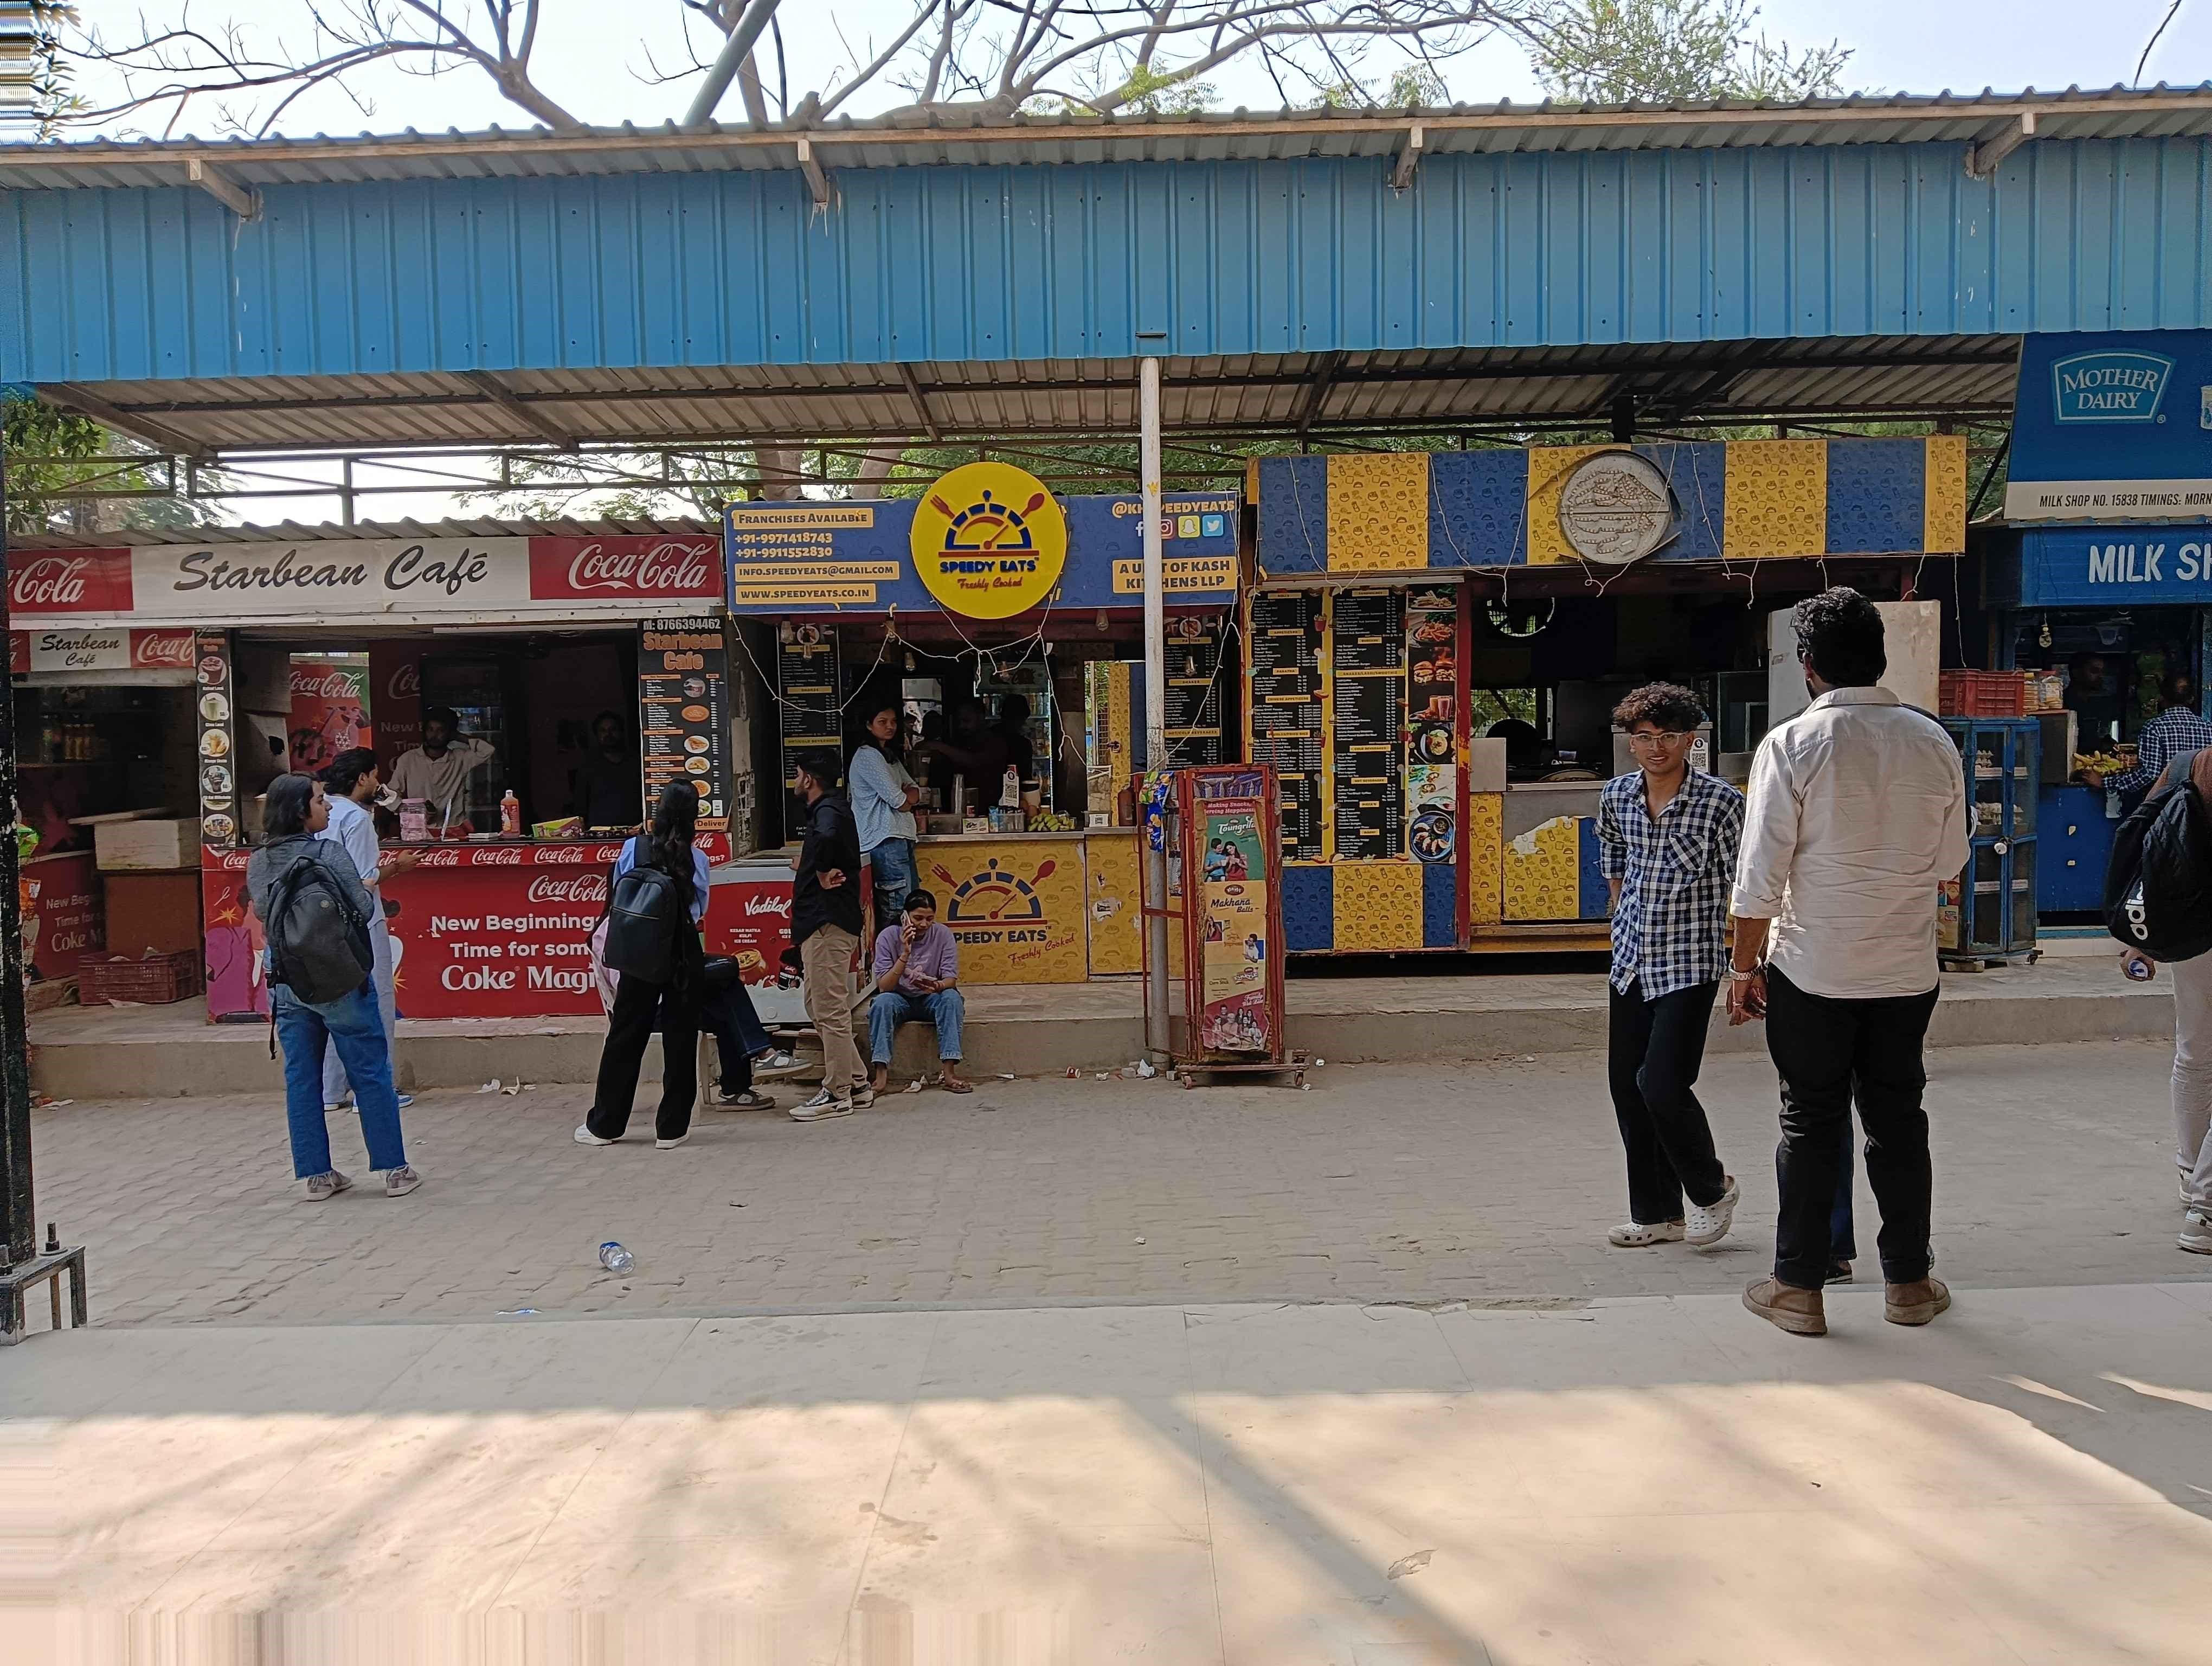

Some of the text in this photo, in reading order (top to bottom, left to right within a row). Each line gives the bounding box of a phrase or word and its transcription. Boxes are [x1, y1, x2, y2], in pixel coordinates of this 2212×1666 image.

[2062, 368, 2159, 394] MOTHER
[2077, 392, 2142, 409] DAIRY
[2039, 495, 2063, 507] MILK
[2065, 495, 2090, 507] SHOP
[2092, 494, 2108, 507] NO.
[2111, 494, 2138, 506] 15838
[2140, 493, 2182, 505] TIMINGS:
[734, 532, 833, 543] +91-9971418743
[735, 547, 833, 558] +91-9911552830
[173, 544, 488, 595] Starbean Café
[568, 543, 716, 591] Coca-Cola
[940, 561, 995, 573] SPEEDY
[1000, 560, 1036, 573] EATS
[1118, 560, 1230, 574] A UT OF KASH
[2088, 544, 2165, 583] MILK
[957, 576, 1024, 592] Freshly Cooked
[1126, 575, 1225, 588] KIHENS LLP
[643, 618, 722, 630] M: 8766394462
[40, 633, 120, 651] Starbean
[65, 652, 97, 667] Café
[664, 651, 704, 670] Cafe
[472, 848, 523, 865] Coca-Cola
[534, 846, 586, 863] Coca-Cola
[710, 854, 725, 863] gs?
[744, 895, 792, 919] Vadilal
[1210, 898, 1251, 908] Makhana
[432, 913, 600, 933] New Beginning
[953, 931, 1003, 944] PEEDY
[1008, 929, 1047, 943] EATS
[449, 941, 589, 958] Time for som
[1007, 933, 1075, 964] Freshly Cooked
[442, 964, 596, 994] Coke Magi
